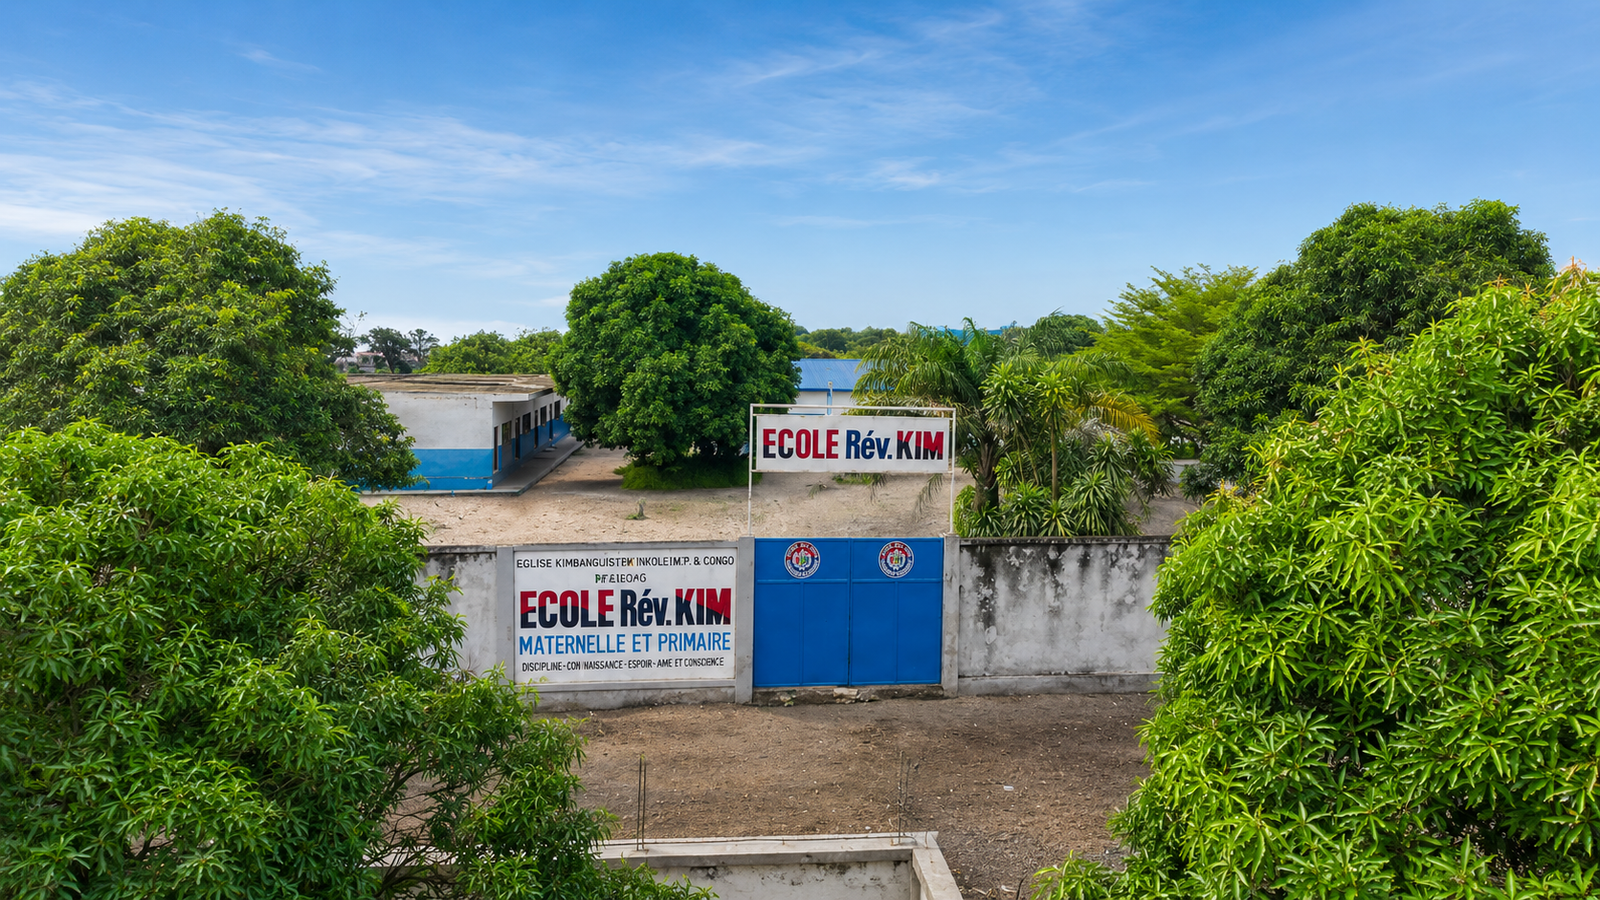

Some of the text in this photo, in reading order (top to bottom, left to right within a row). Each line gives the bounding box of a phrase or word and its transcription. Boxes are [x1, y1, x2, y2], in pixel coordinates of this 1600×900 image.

[763, 429, 944, 460] ECOLE Rév. KIM
[517, 558, 552, 568] EGLISE
[693, 556, 701, 566] &
[703, 556, 735, 566] CONGO
[520, 588, 731, 629] ECOLE Rév. KIM
[519, 632, 731, 655] MATERNELLE ET PRIMAIRE
[674, 658, 684, 668] ET
